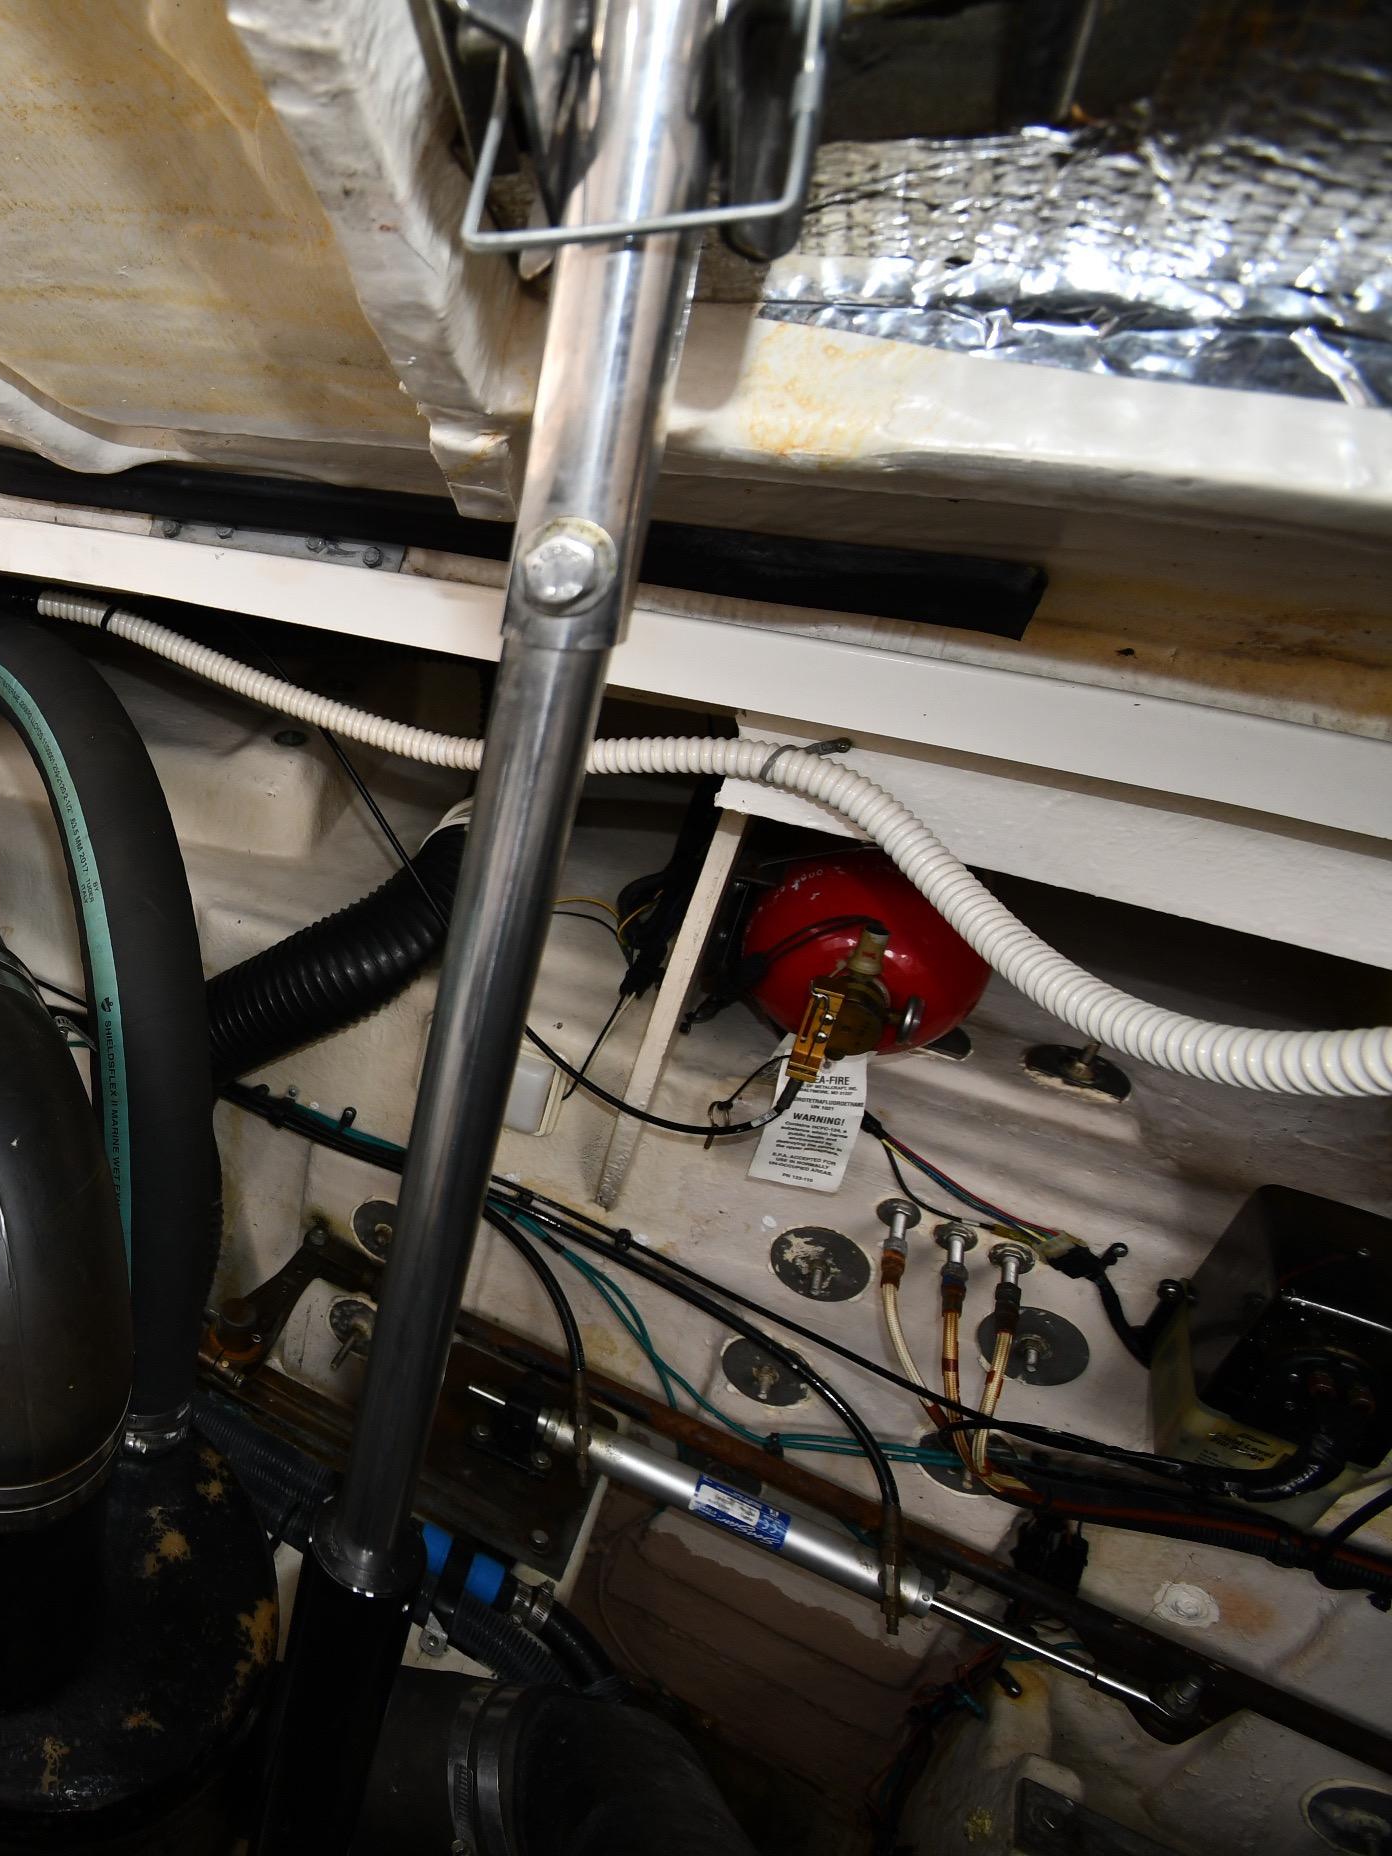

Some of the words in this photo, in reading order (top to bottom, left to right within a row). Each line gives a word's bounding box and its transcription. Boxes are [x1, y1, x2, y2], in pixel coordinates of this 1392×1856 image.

[79, 853, 88, 872] 2017
[104, 1020, 117, 1097] SHIELDSFLEX
[815, 1075, 850, 1085] EA-FIRE
[793, 1112, 845, 1126] WARNING!
[111, 1108, 120, 1153] MARINE
[790, 1154, 821, 1162] ACCEPTED
[796, 1160, 829, 1169] NORMALLY
[112, 1156, 121, 1183] WET
